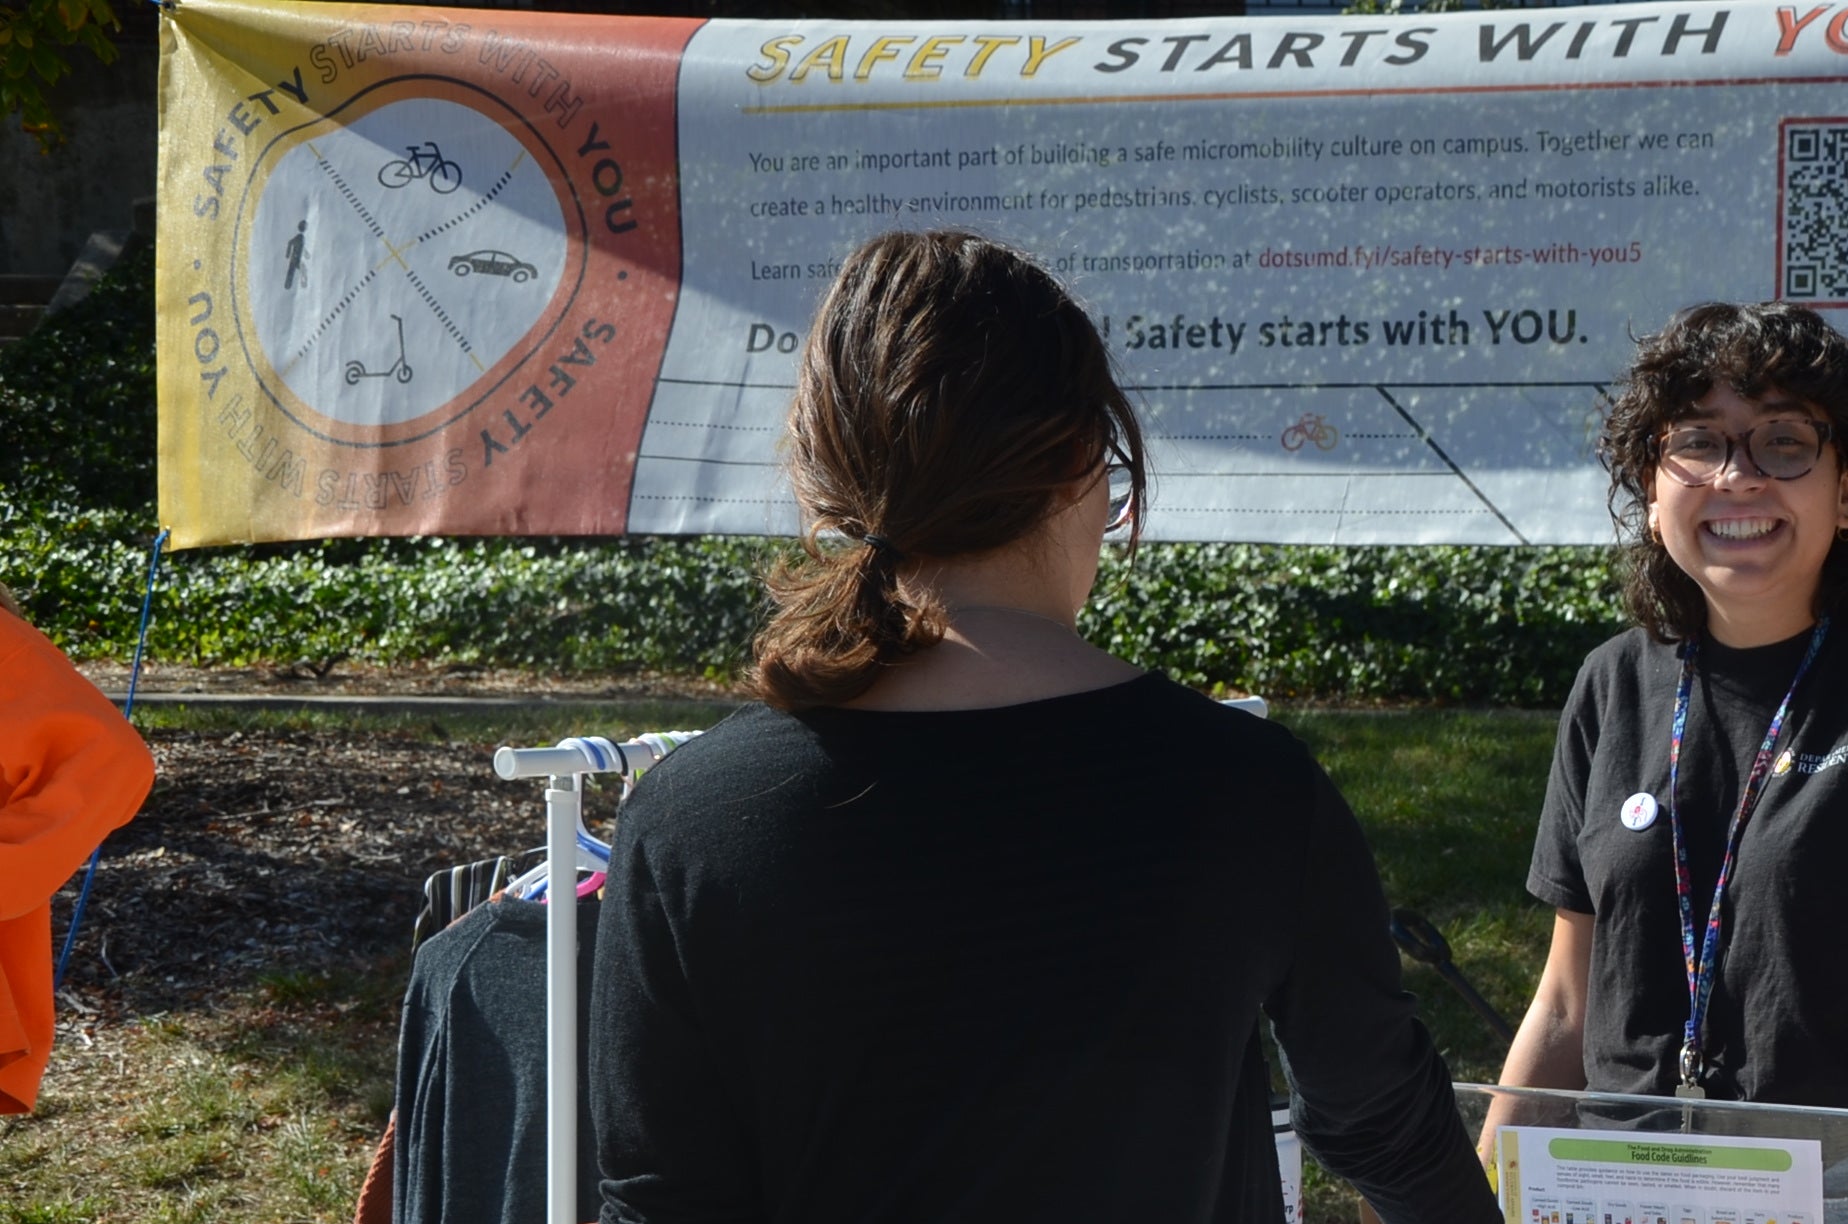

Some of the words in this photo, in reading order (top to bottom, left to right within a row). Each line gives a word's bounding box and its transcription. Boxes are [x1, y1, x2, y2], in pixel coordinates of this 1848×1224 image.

[746, 34, 1084, 86] SAFETY
[1092, 26, 1437, 75] STARTS
[1478, 10, 1731, 63] WITH
[194, 67, 310, 221] SAFETY
[310, 20, 473, 85] STARTS
[477, 33, 584, 130] WITH
[575, 121, 638, 235] YOU
[750, 153, 784, 173] You
[790, 156, 820, 171] are
[826, 154, 848, 170] an
[855, 149, 951, 172] important
[958, 148, 997, 171] part
[1005, 145, 1025, 165] of
[1030, 143, 1110, 167] building
[1117, 147, 1127, 162] a
[1134, 141, 1175, 162] safe
[1182, 136, 1324, 162] micromobility
[1330, 135, 1403, 158] culture
[1410, 138, 1436, 155] on
[1442, 137, 1529, 158] campus.
[1536, 129, 1631, 156] Together
[1638, 133, 1669, 149] we
[1676, 131, 1714, 149] can
[750, 198, 809, 217] create
[815, 200, 825, 216] a
[832, 193, 901, 219] healthy
[908, 190, 1033, 212] environment
[1040, 188, 1067, 210] for
[1074, 186, 1197, 212] pedestrians,
[1203, 183, 1285, 209] cyclists,
[1291, 182, 1369, 203] scooter
[1375, 181, 1481, 206] operators,
[1489, 178, 1527, 199] and
[1535, 175, 1636, 199] motorists
[1643, 174, 1700, 198] alike.
[751, 260, 801, 281] Learn
[1056, 252, 1077, 273] of
[1083, 249, 1225, 273] transportation
[1232, 250, 1252, 268] at
[188, 292, 229, 400] YOU
[746, 323, 799, 354] Do
[1125, 314, 1247, 355] Safety
[1258, 314, 1371, 348] starts
[1383, 309, 1470, 346] with
[1483, 308, 1588, 346] YOU.
[477, 317, 616, 469] SAFETY
[216, 392, 306, 491] WITH
[316, 446, 467, 511] STARTS
[1631, 1151, 1650, 1162] Food
[1651, 1152, 1670, 1163] Code
